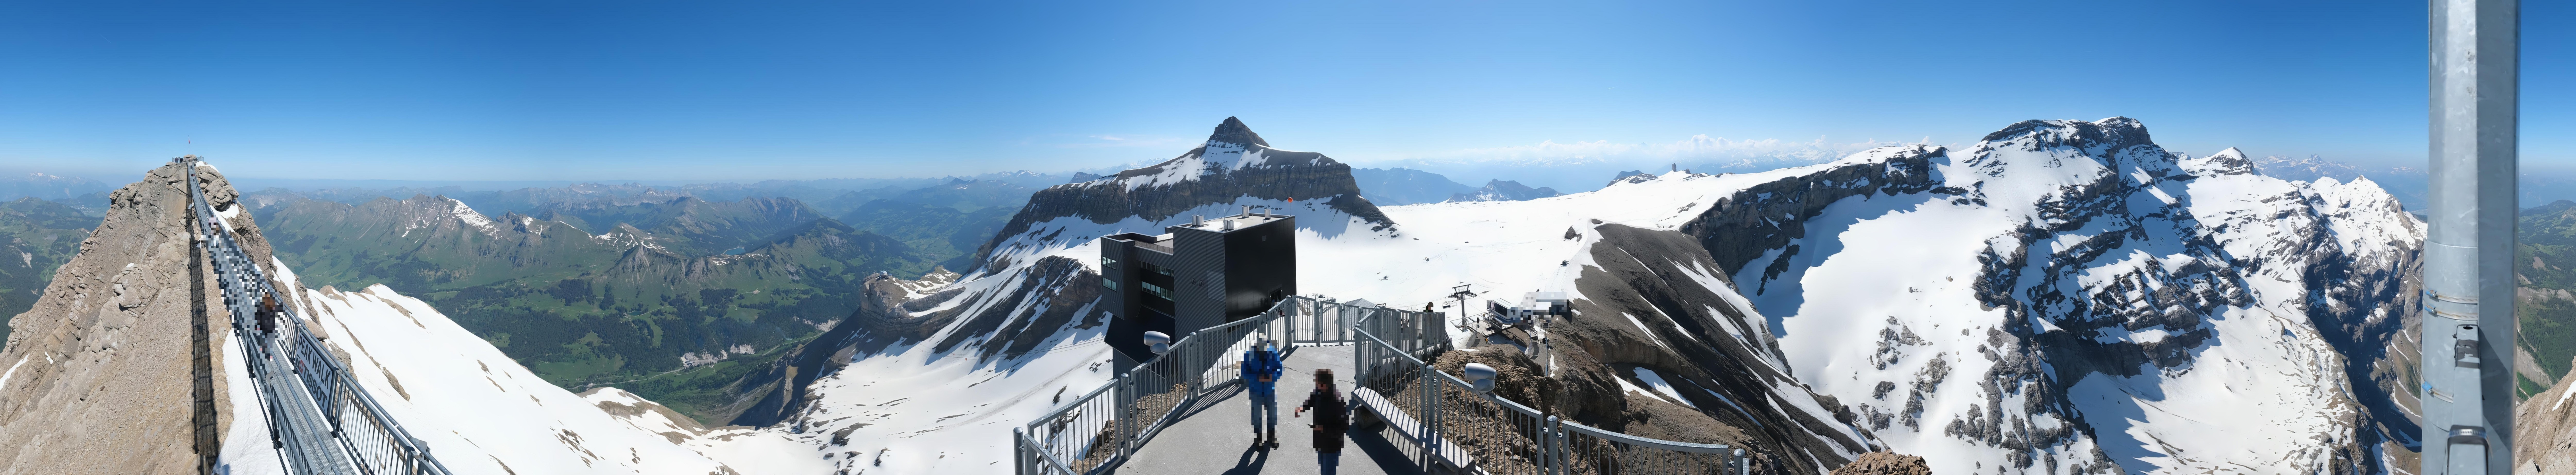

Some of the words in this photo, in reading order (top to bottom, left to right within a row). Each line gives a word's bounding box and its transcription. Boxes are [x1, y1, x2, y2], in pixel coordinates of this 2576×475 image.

[298, 335, 312, 365] PEAK
[312, 352, 331, 390] WALK
[304, 364, 327, 408] TISSOT
